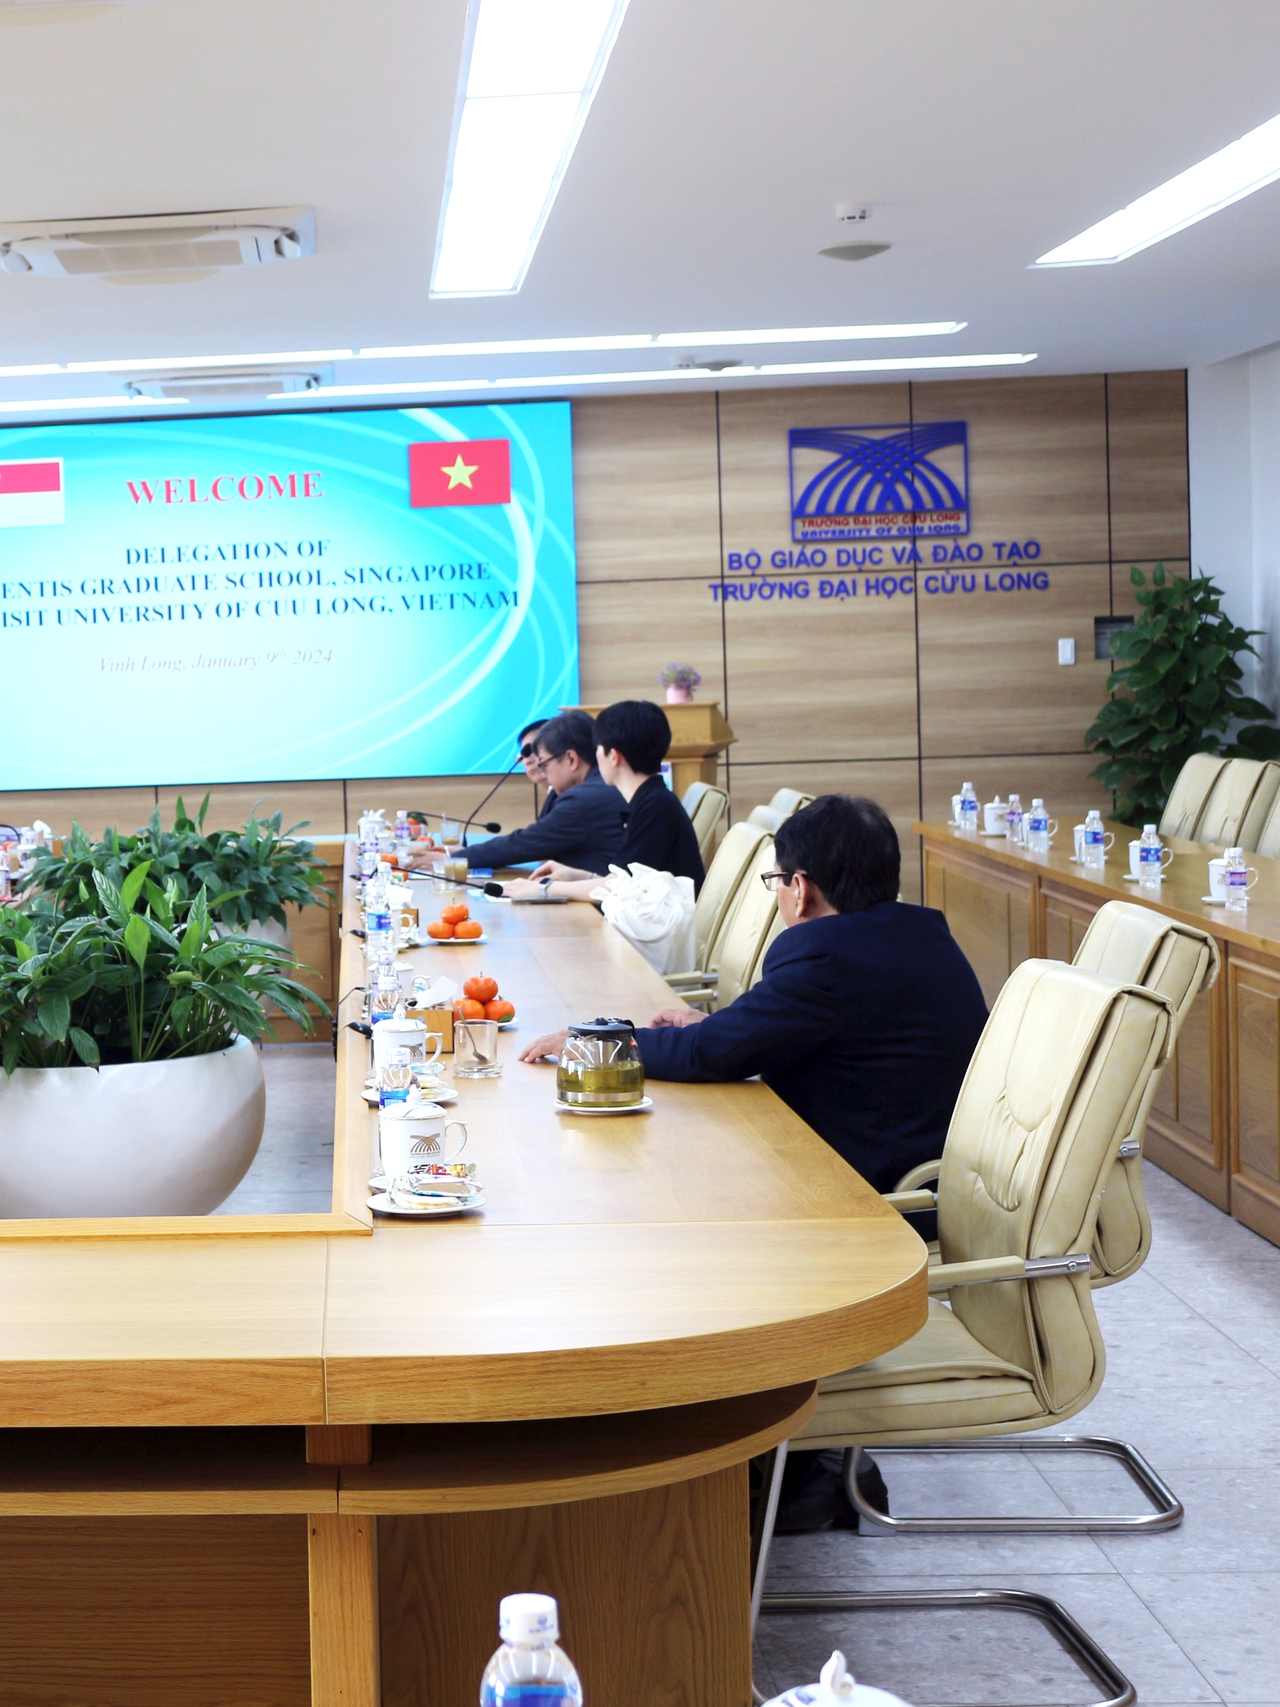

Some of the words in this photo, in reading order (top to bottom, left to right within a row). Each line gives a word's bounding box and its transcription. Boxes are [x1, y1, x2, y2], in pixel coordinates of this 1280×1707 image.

[126, 471, 324, 505] WELCOME
[930, 511, 961, 523] LONG
[125, 541, 289, 566] DELEGATION
[297, 539, 332, 559] OF
[728, 547, 762, 576] BỘ
[771, 544, 827, 569] GIÁO
[836, 546, 883, 572] DỤC
[891, 540, 923, 565] VÀ
[931, 538, 984, 563] ĐÀO
[992, 540, 1041, 566] TẠO
[80, 573, 218, 597] GRADUATE
[225, 569, 337, 590] SCHOOL,
[343, 561, 491, 585] SINGAPORE
[708, 576, 811, 601] TRƯỜNG
[818, 577, 857, 601] ĐẠI
[865, 575, 914, 599] HỌC
[924, 569, 976, 594] CỬU
[984, 571, 1050, 592] LONG
[56, 603, 209, 626] UNIVERSITY
[215, 600, 249, 619] OF
[255, 598, 306, 618] CUU
[315, 595, 394, 616] LONG,
[401, 590, 520, 611] VIETNAM
[99, 656, 136, 672] Vinh
[141, 655, 186, 674] Long,
[192, 653, 261, 673] January
[292, 649, 333, 666] 2024
